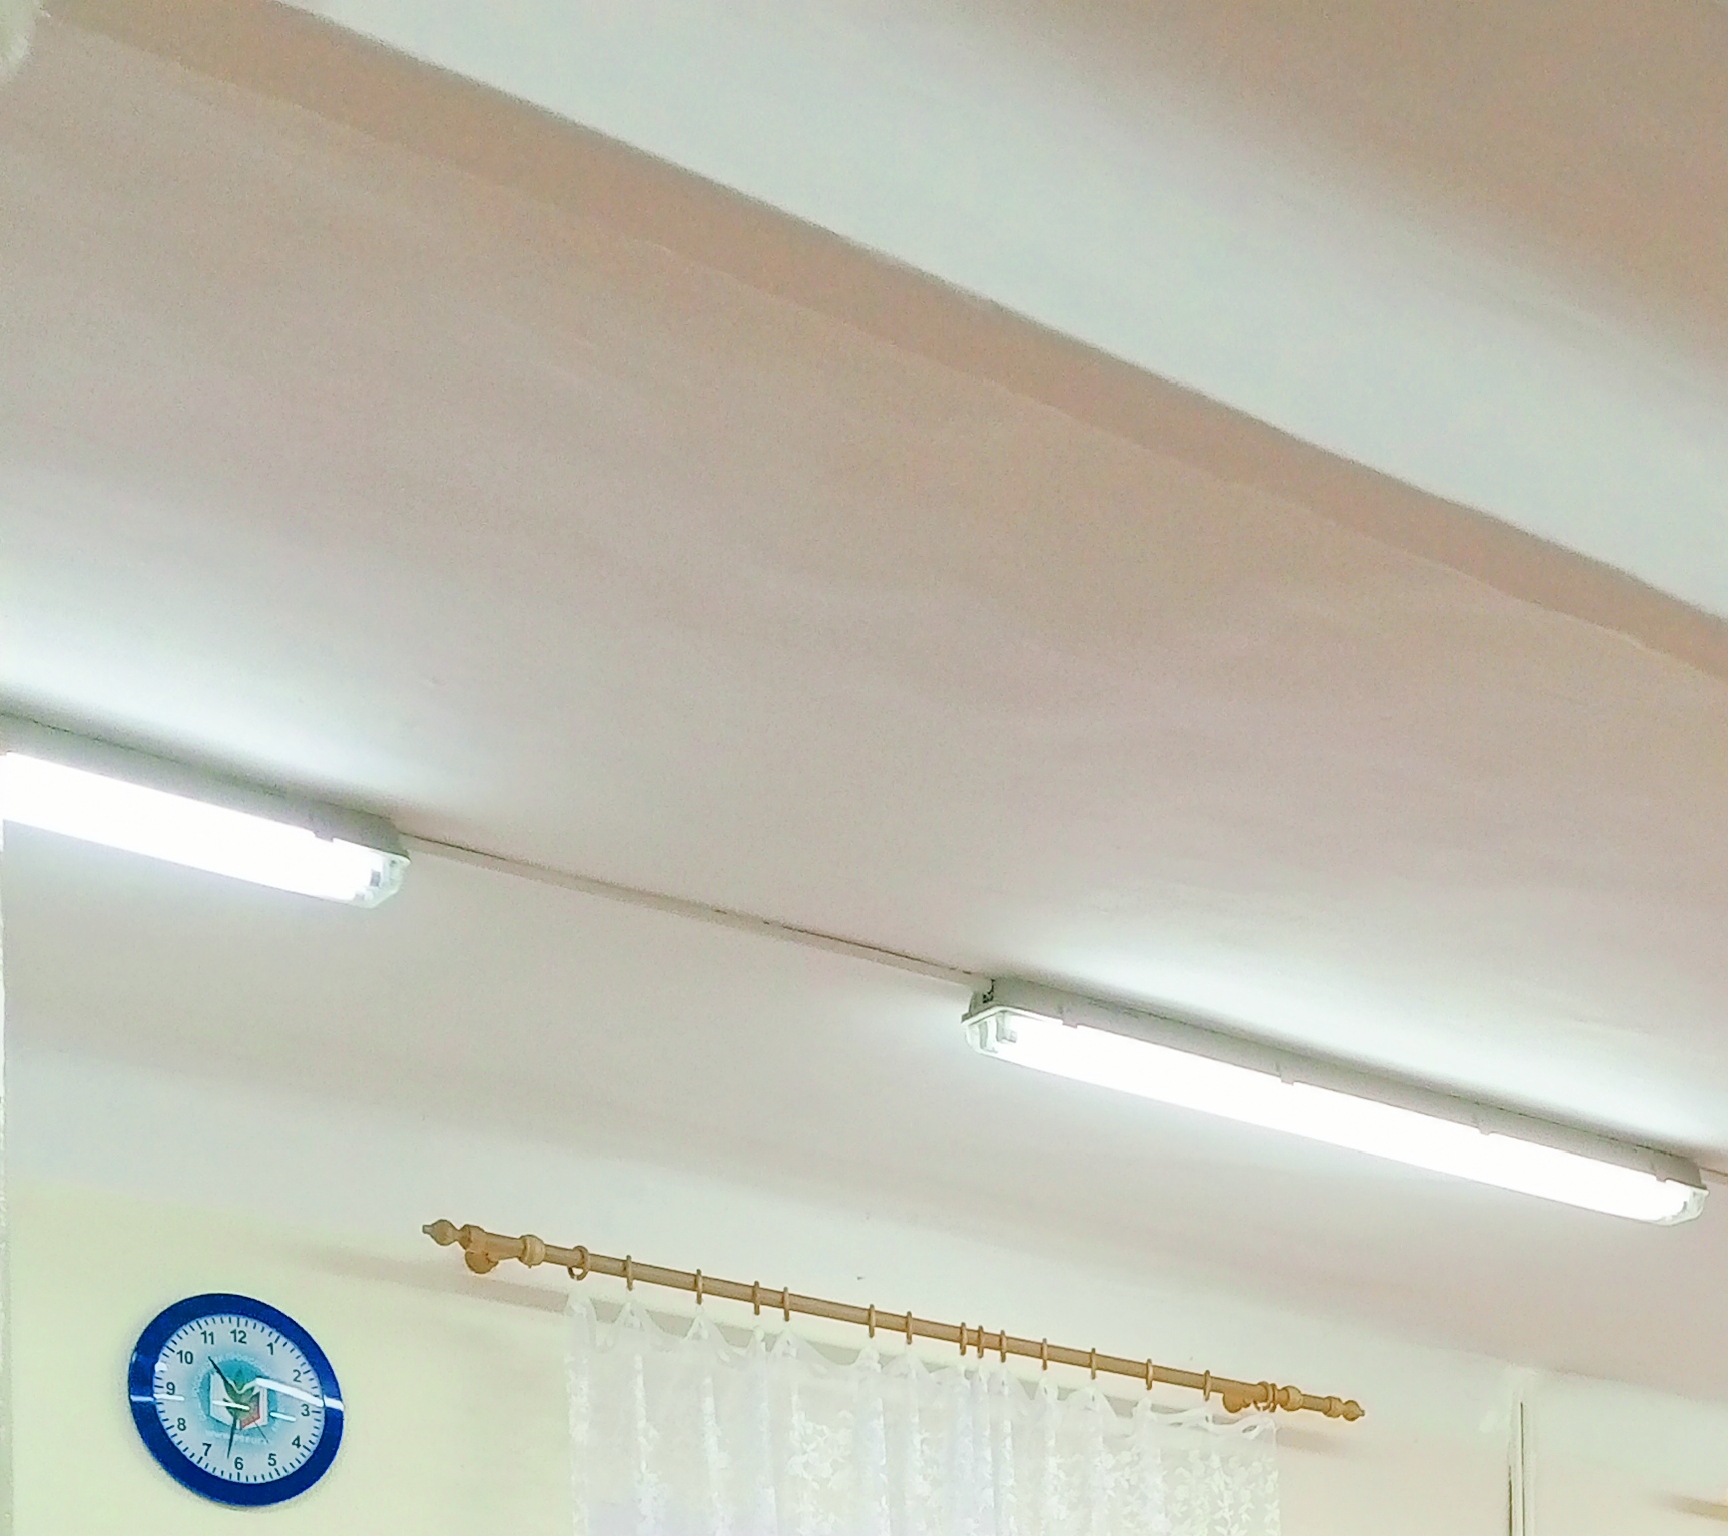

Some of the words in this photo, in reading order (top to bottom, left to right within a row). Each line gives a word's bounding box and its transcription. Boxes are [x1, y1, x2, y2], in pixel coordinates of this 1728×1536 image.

[200, 1331, 215, 1345] 11
[230, 1329, 247, 1344] 12
[266, 1342, 274, 1355] 1
[176, 1350, 194, 1365] 10
[292, 1369, 301, 1382] 2
[166, 1381, 176, 1395] 9
[301, 1404, 310, 1416] 3
[177, 1417, 187, 1431] 8
[291, 1435, 302, 1448] 4
[202, 1443, 212, 1457] 7
[234, 1457, 244, 1470] 6
[267, 1453, 277, 1466] 5
